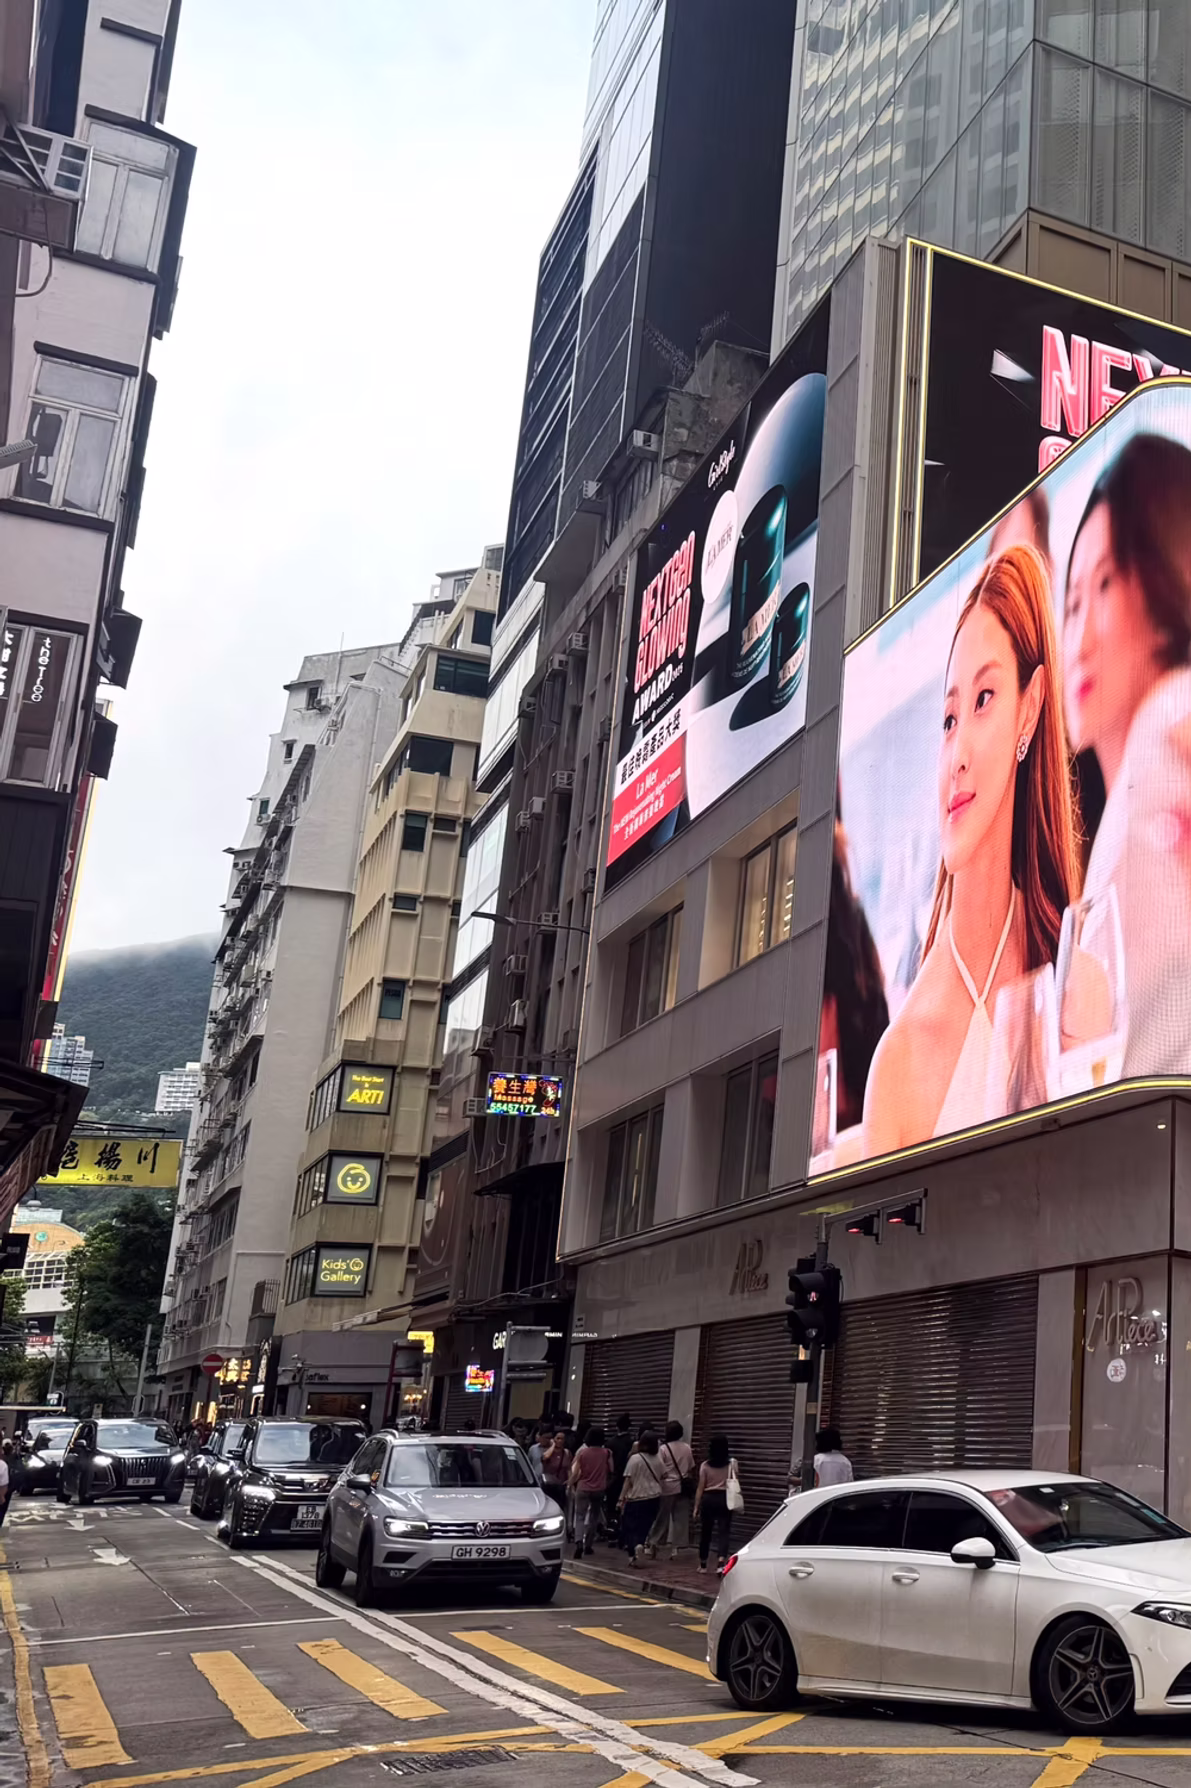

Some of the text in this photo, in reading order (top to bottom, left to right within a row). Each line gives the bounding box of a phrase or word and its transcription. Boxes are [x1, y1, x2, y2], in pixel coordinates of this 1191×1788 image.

[632, 663, 673, 726] AWARD
[320, 1270, 362, 1285] Gallery
[456, 1546, 507, 1557] GH 9298
